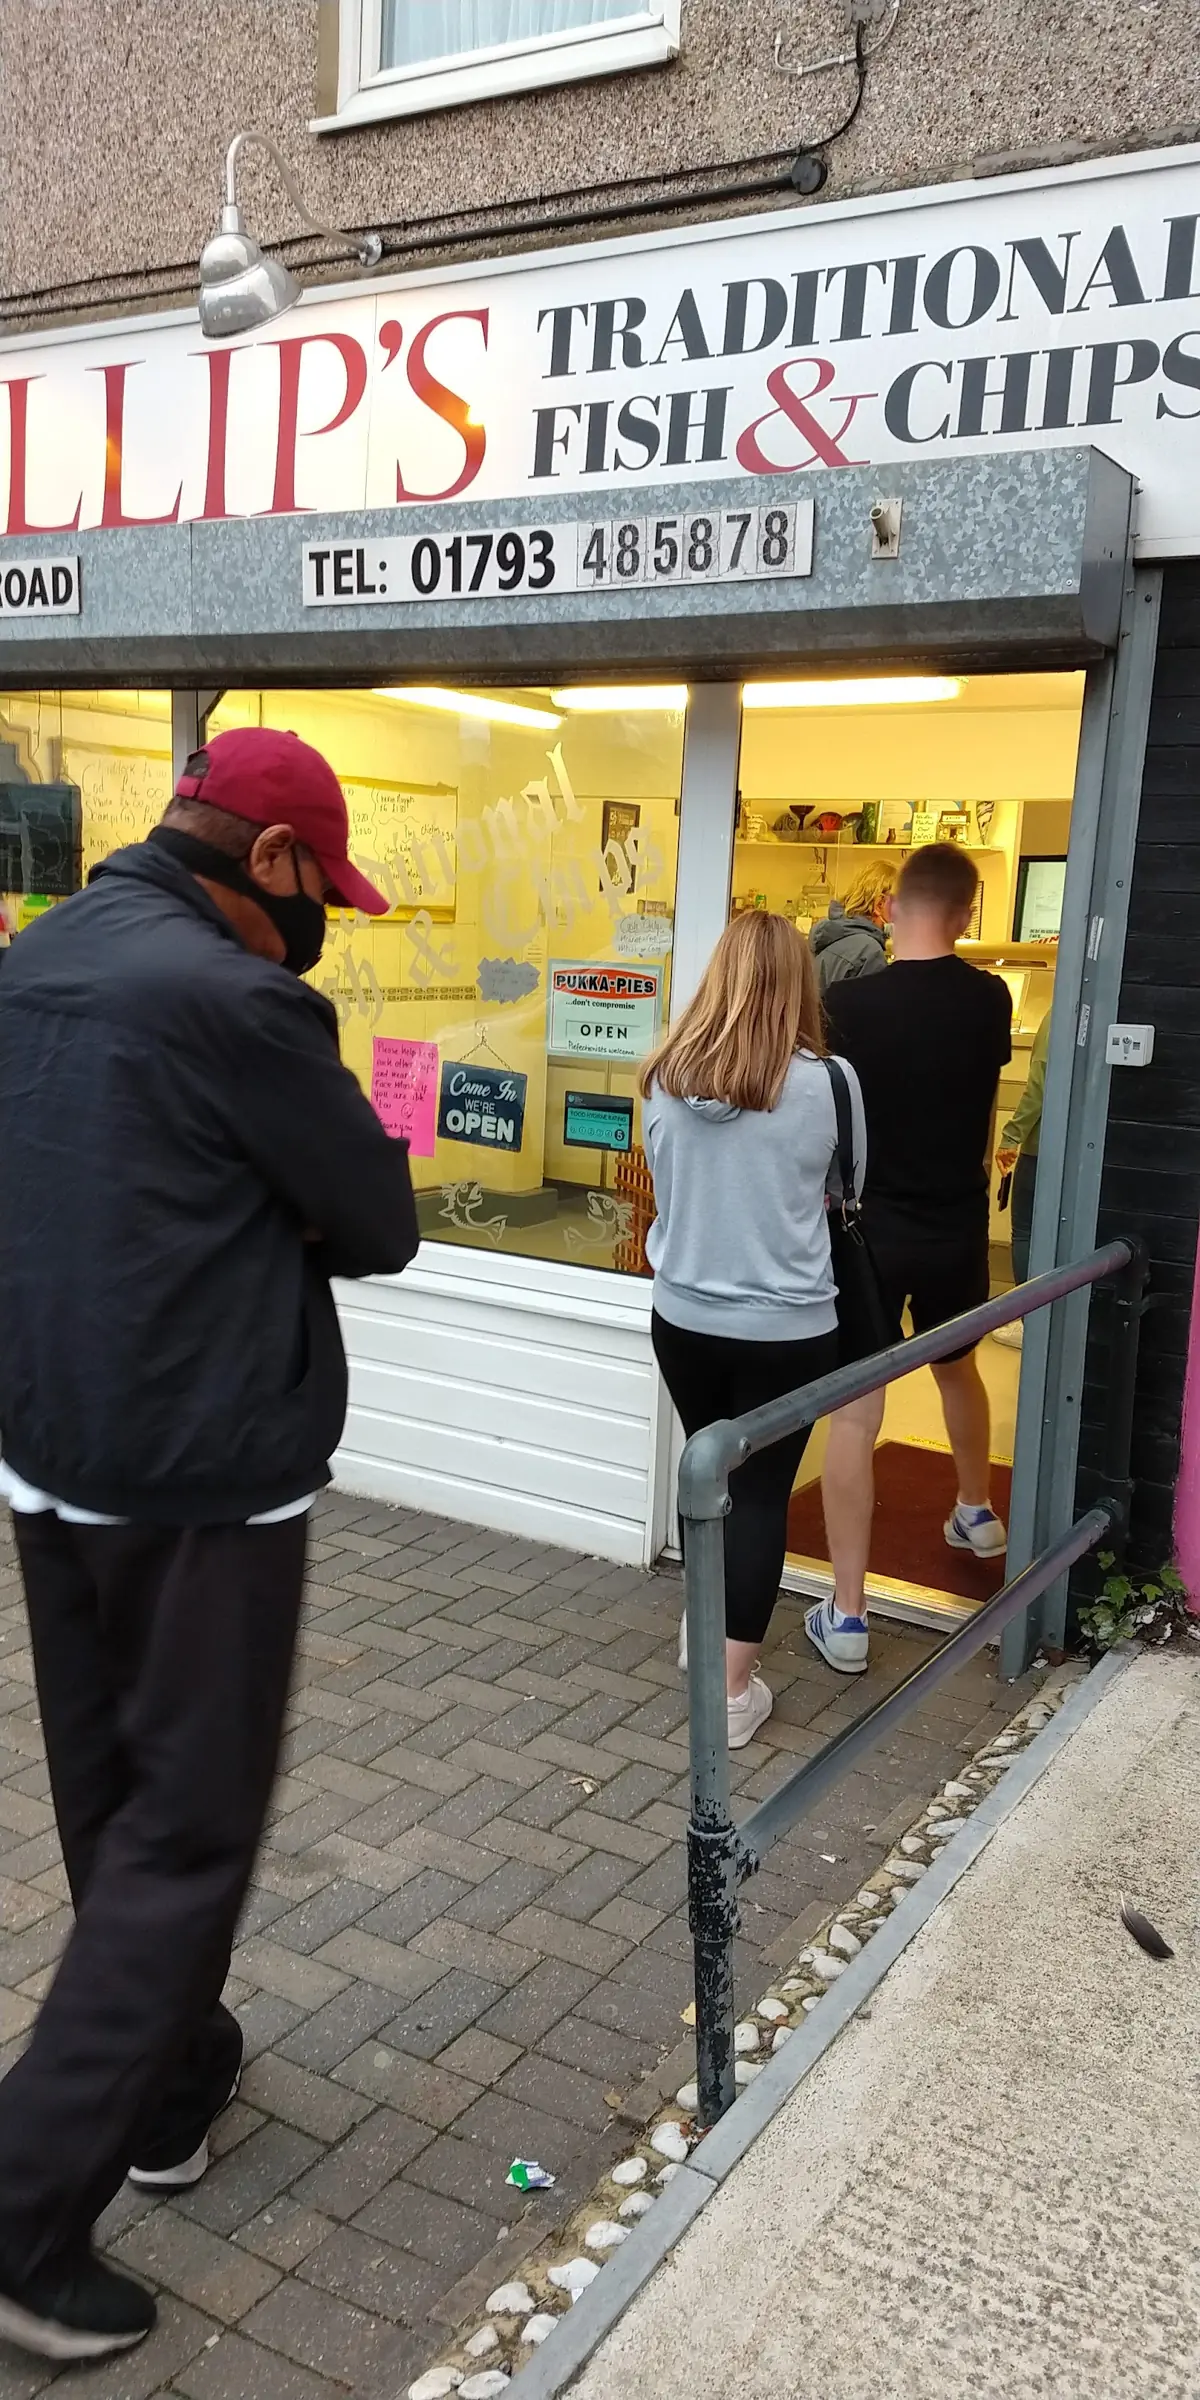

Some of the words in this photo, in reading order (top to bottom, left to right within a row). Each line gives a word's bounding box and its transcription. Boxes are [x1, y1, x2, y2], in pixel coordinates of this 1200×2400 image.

[528, 386, 734, 479] FISH
[735, 357, 878, 475] &
[885, 330, 1200, 443] CHIPS
[309, 548, 387, 596] TEL:
[411, 530, 555, 594] 01793
[583, 510, 788, 579] 485878
[0, 566, 73, 609] OAD
[556, 975, 654, 994] PUKKA-PIES
[592, 1000, 636, 1011] compromise
[580, 1024, 628, 1039] OPEN
[418, 1047, 436, 1061] kep
[450, 1071, 491, 1097] Come
[494, 1080, 517, 1102] In
[465, 1098, 495, 1114] WE'RE
[446, 1109, 514, 1143] OPEN
[616, 1130, 623, 1140] 5
